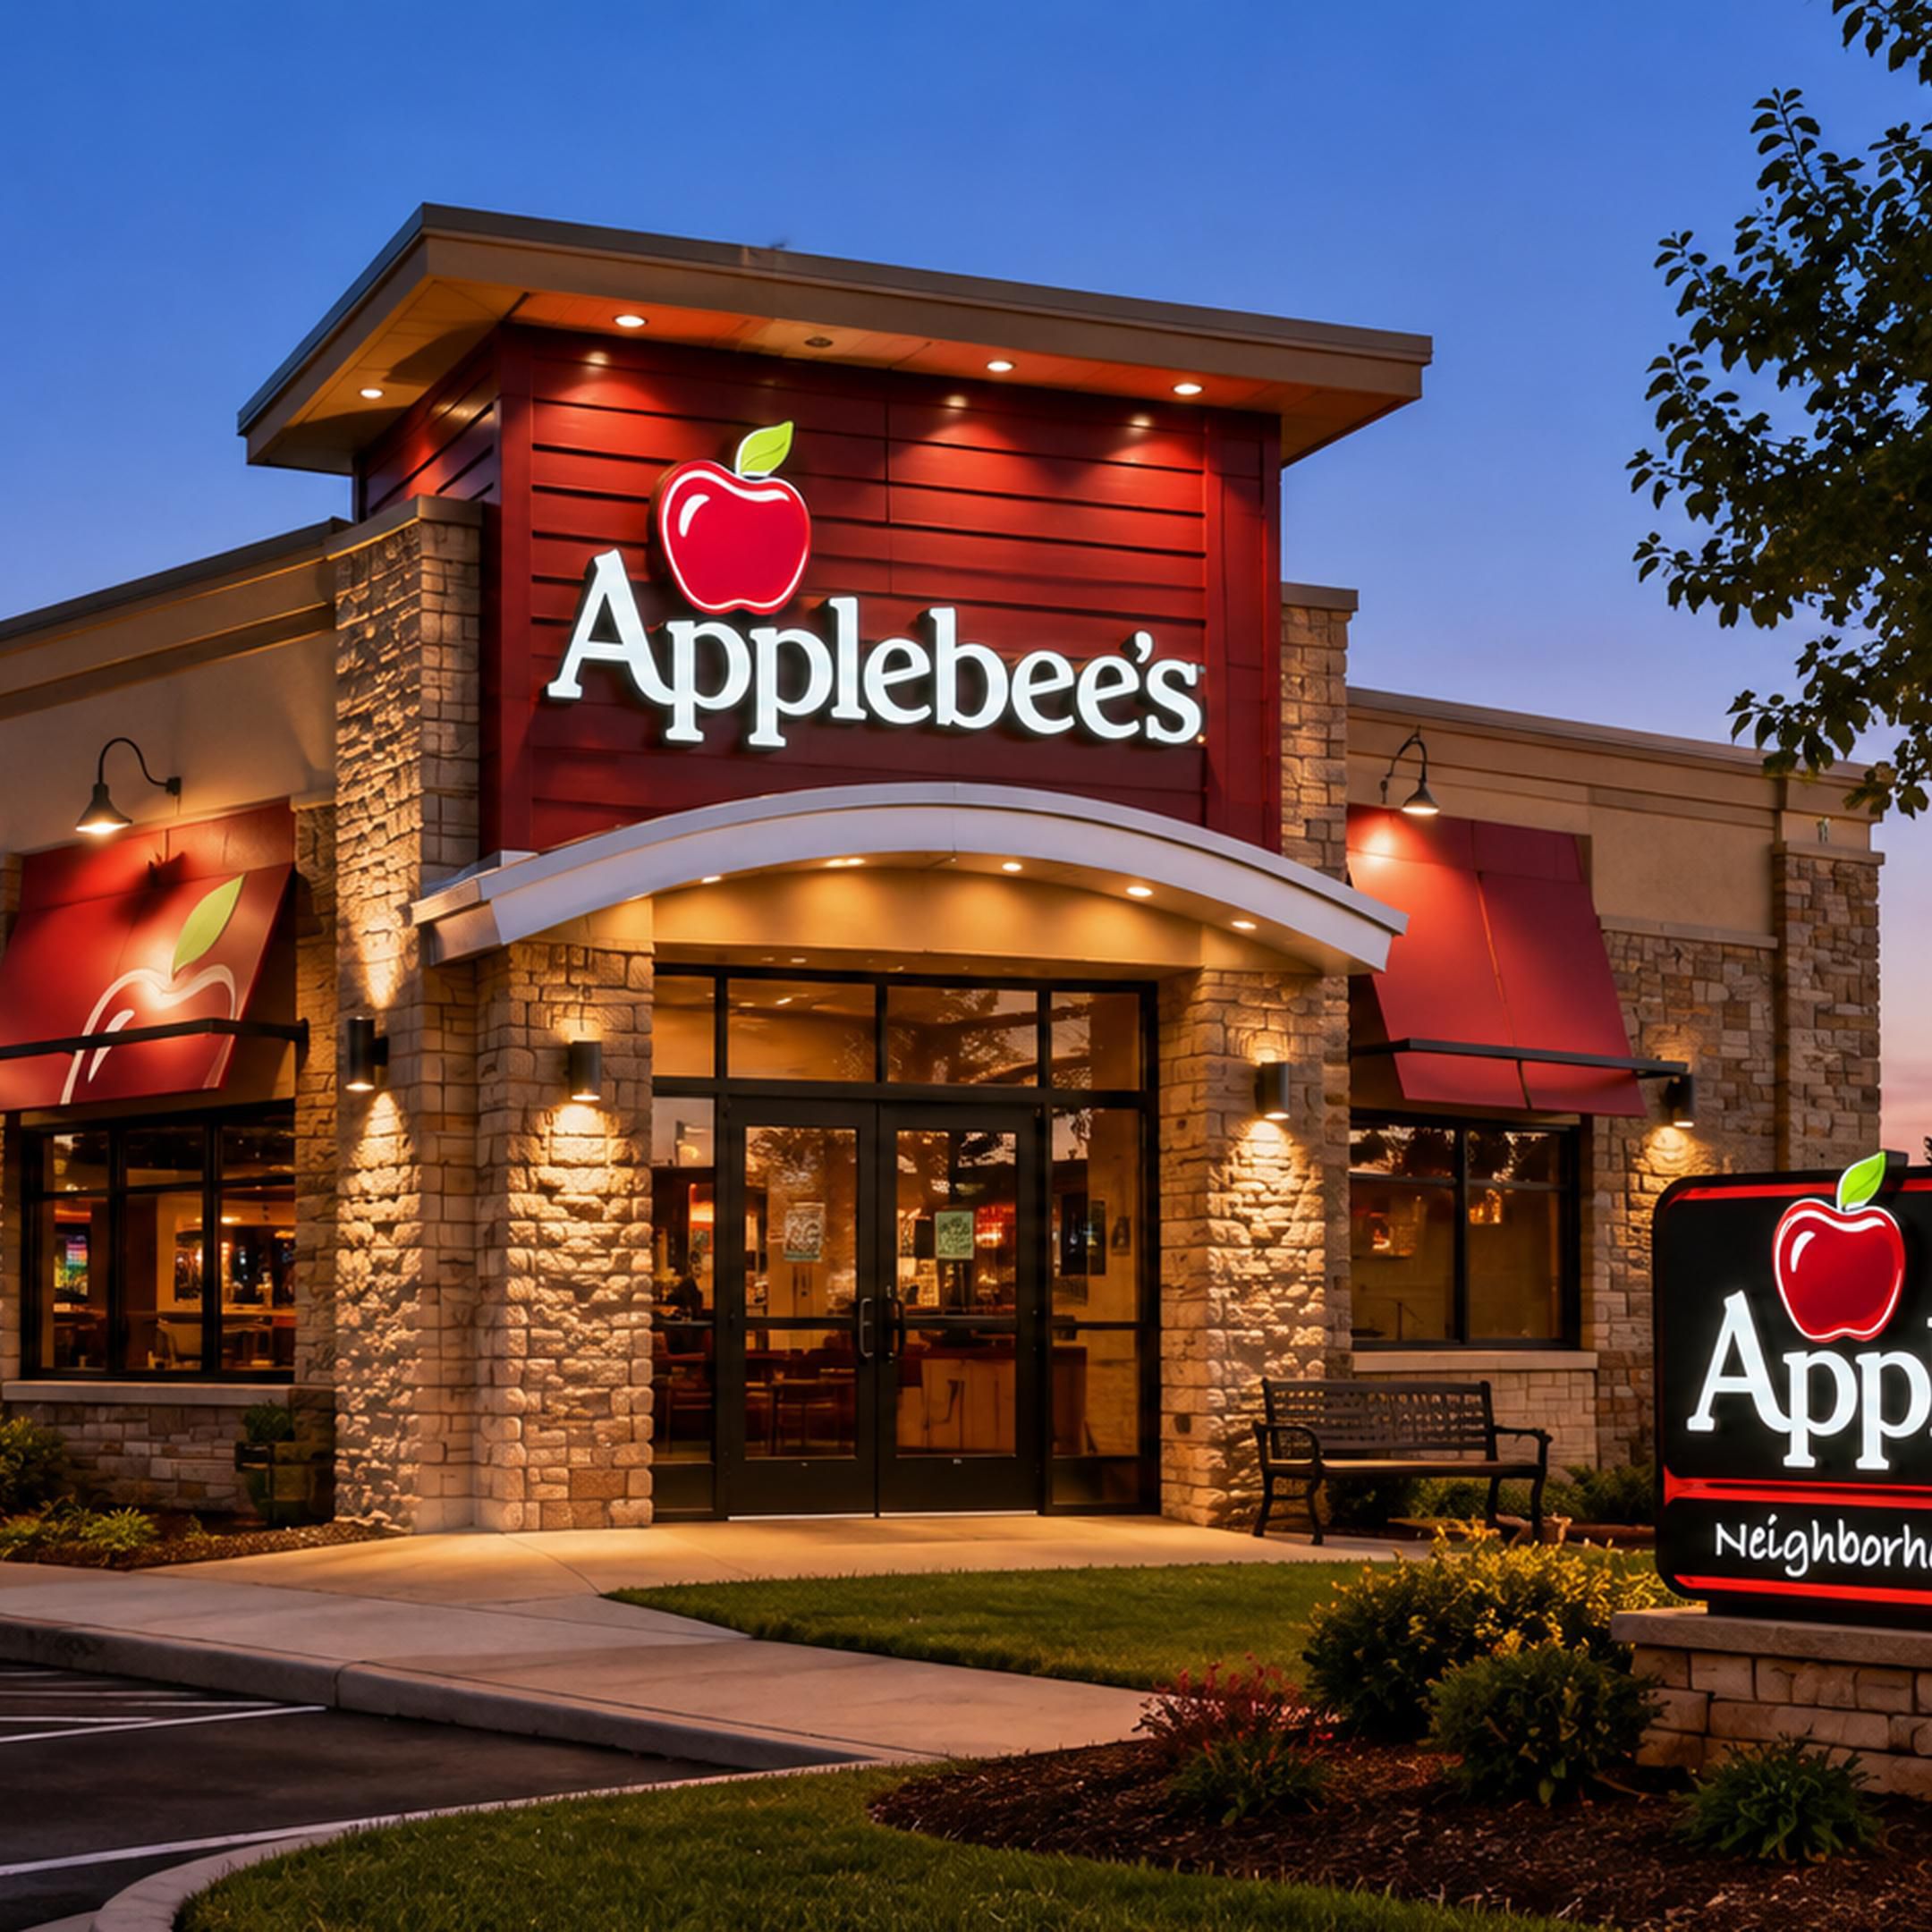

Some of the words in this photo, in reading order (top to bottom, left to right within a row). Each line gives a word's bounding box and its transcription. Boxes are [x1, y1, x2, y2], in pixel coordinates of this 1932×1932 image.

[547, 548, 1203, 747] Applebee's
[1687, 1289, 1932, 1470] App
[1715, 1513, 1932, 1578] Neighborh
